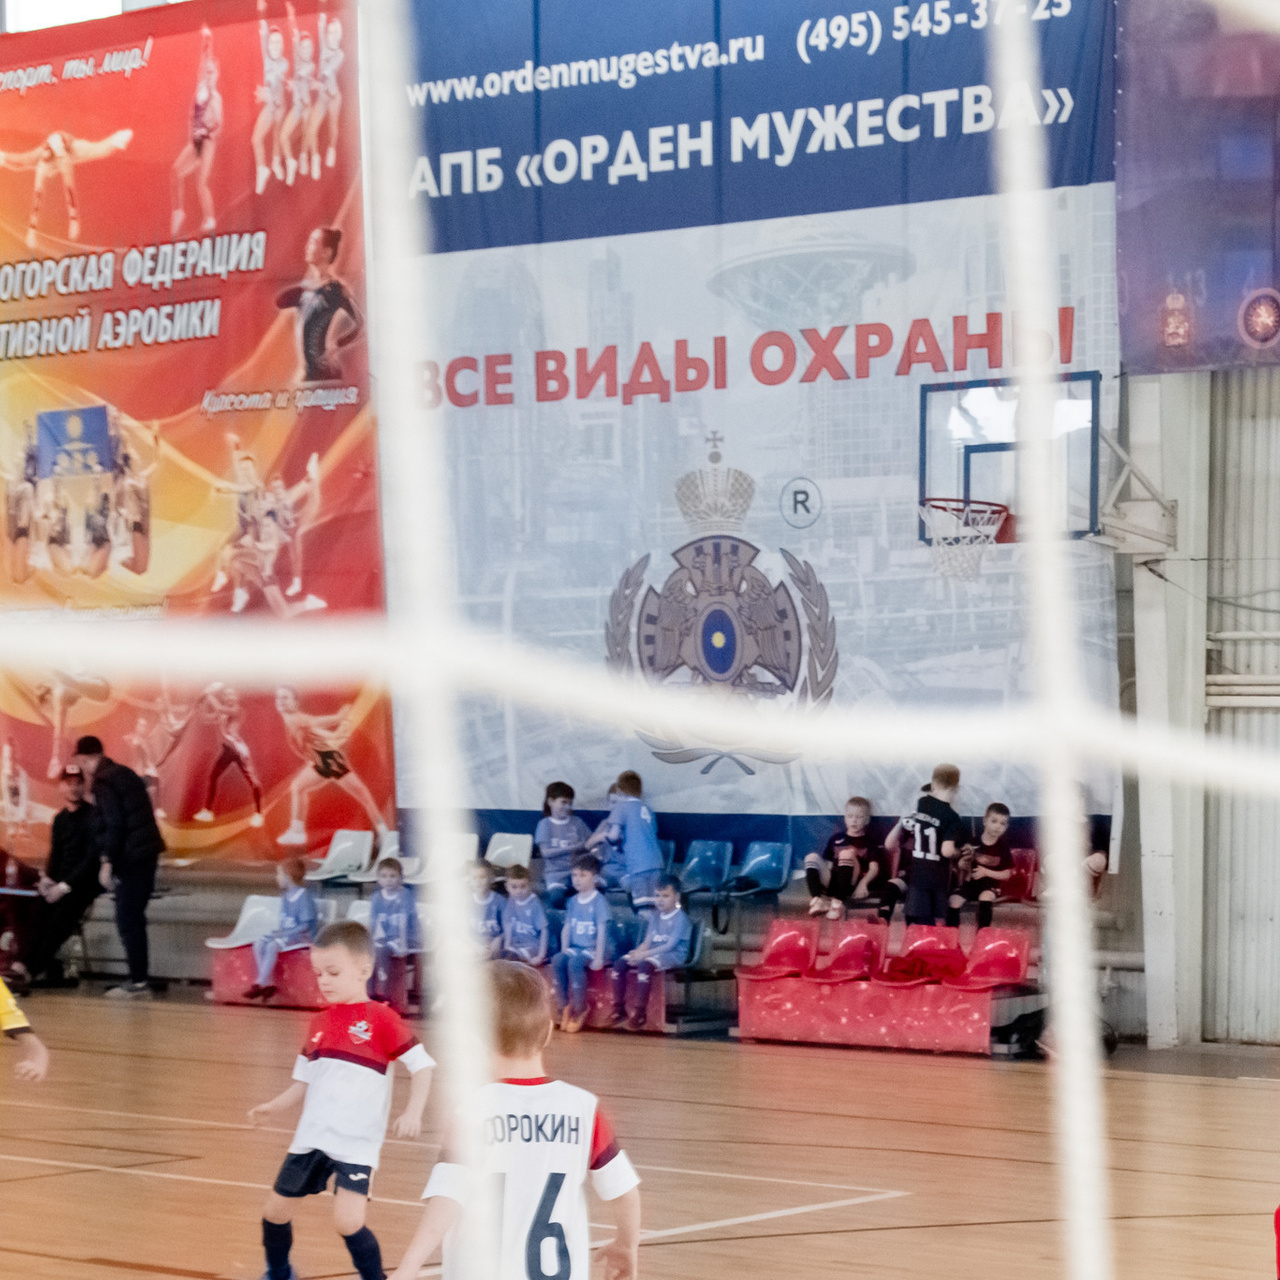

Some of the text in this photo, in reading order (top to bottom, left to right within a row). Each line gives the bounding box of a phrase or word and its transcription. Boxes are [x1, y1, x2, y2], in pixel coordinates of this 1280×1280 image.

[796, 10, 882, 64] (495)
[405, 34, 765, 108] www.ordenmugestva.ru
[408, 147, 504, 199] АПБ
[515, 120, 713, 187] «ОРДЕН
[0, 231, 267, 300] ОГОРСКАЯ ФЕДЕРАЦИЯ
[97, 299, 221, 350] АЭРОБИКИ
[412, 355, 514, 410] ВСЕ
[535, 336, 726, 405] ВИДЫ
[912, 823, 941, 862] 11
[485, 1113, 580, 1145] ОРОКИН
